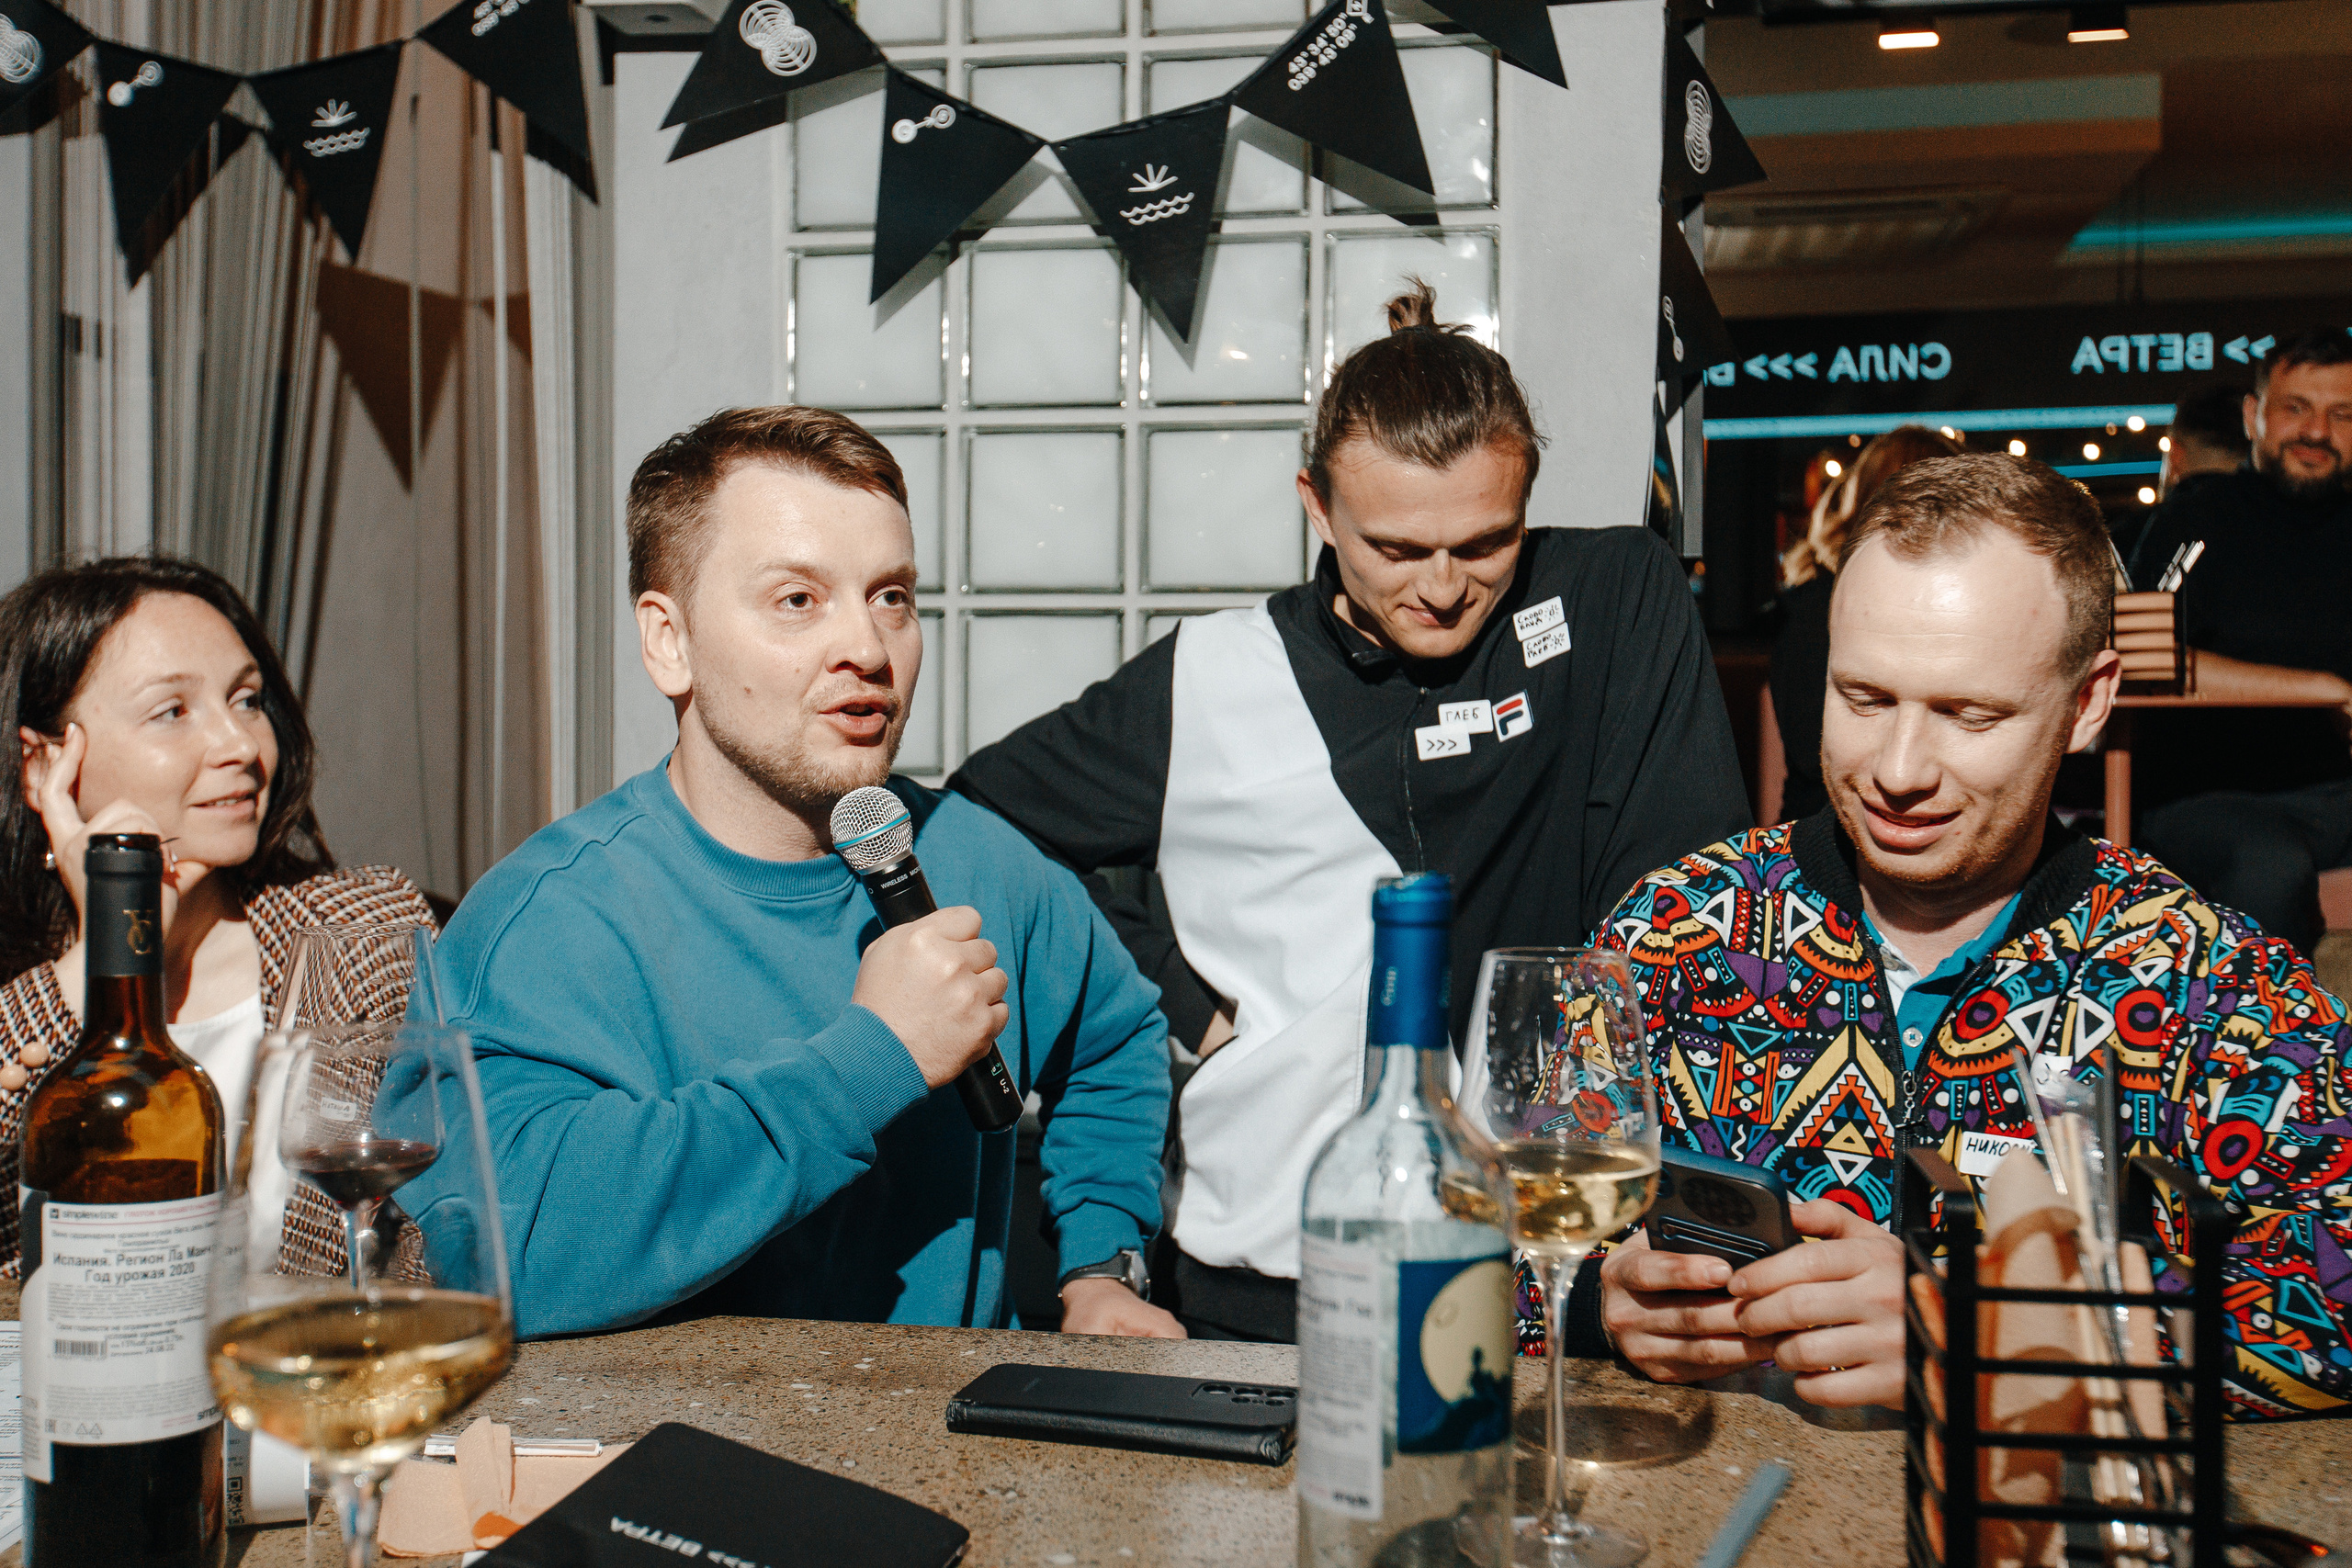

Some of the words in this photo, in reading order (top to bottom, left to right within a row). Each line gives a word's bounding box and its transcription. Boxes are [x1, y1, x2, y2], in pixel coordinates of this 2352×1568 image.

[1445, 707, 1480, 722] ГЛЕБ
[880, 874, 909, 889] WIRELESS
[52, 1253, 112, 1267] Испания.
[116, 1252, 164, 1267] Регион
[168, 1248, 184, 1262] Ла
[85, 1269, 110, 1282] Год
[115, 1268, 165, 1284] урожая
[169, 1261, 196, 1278] 2020
